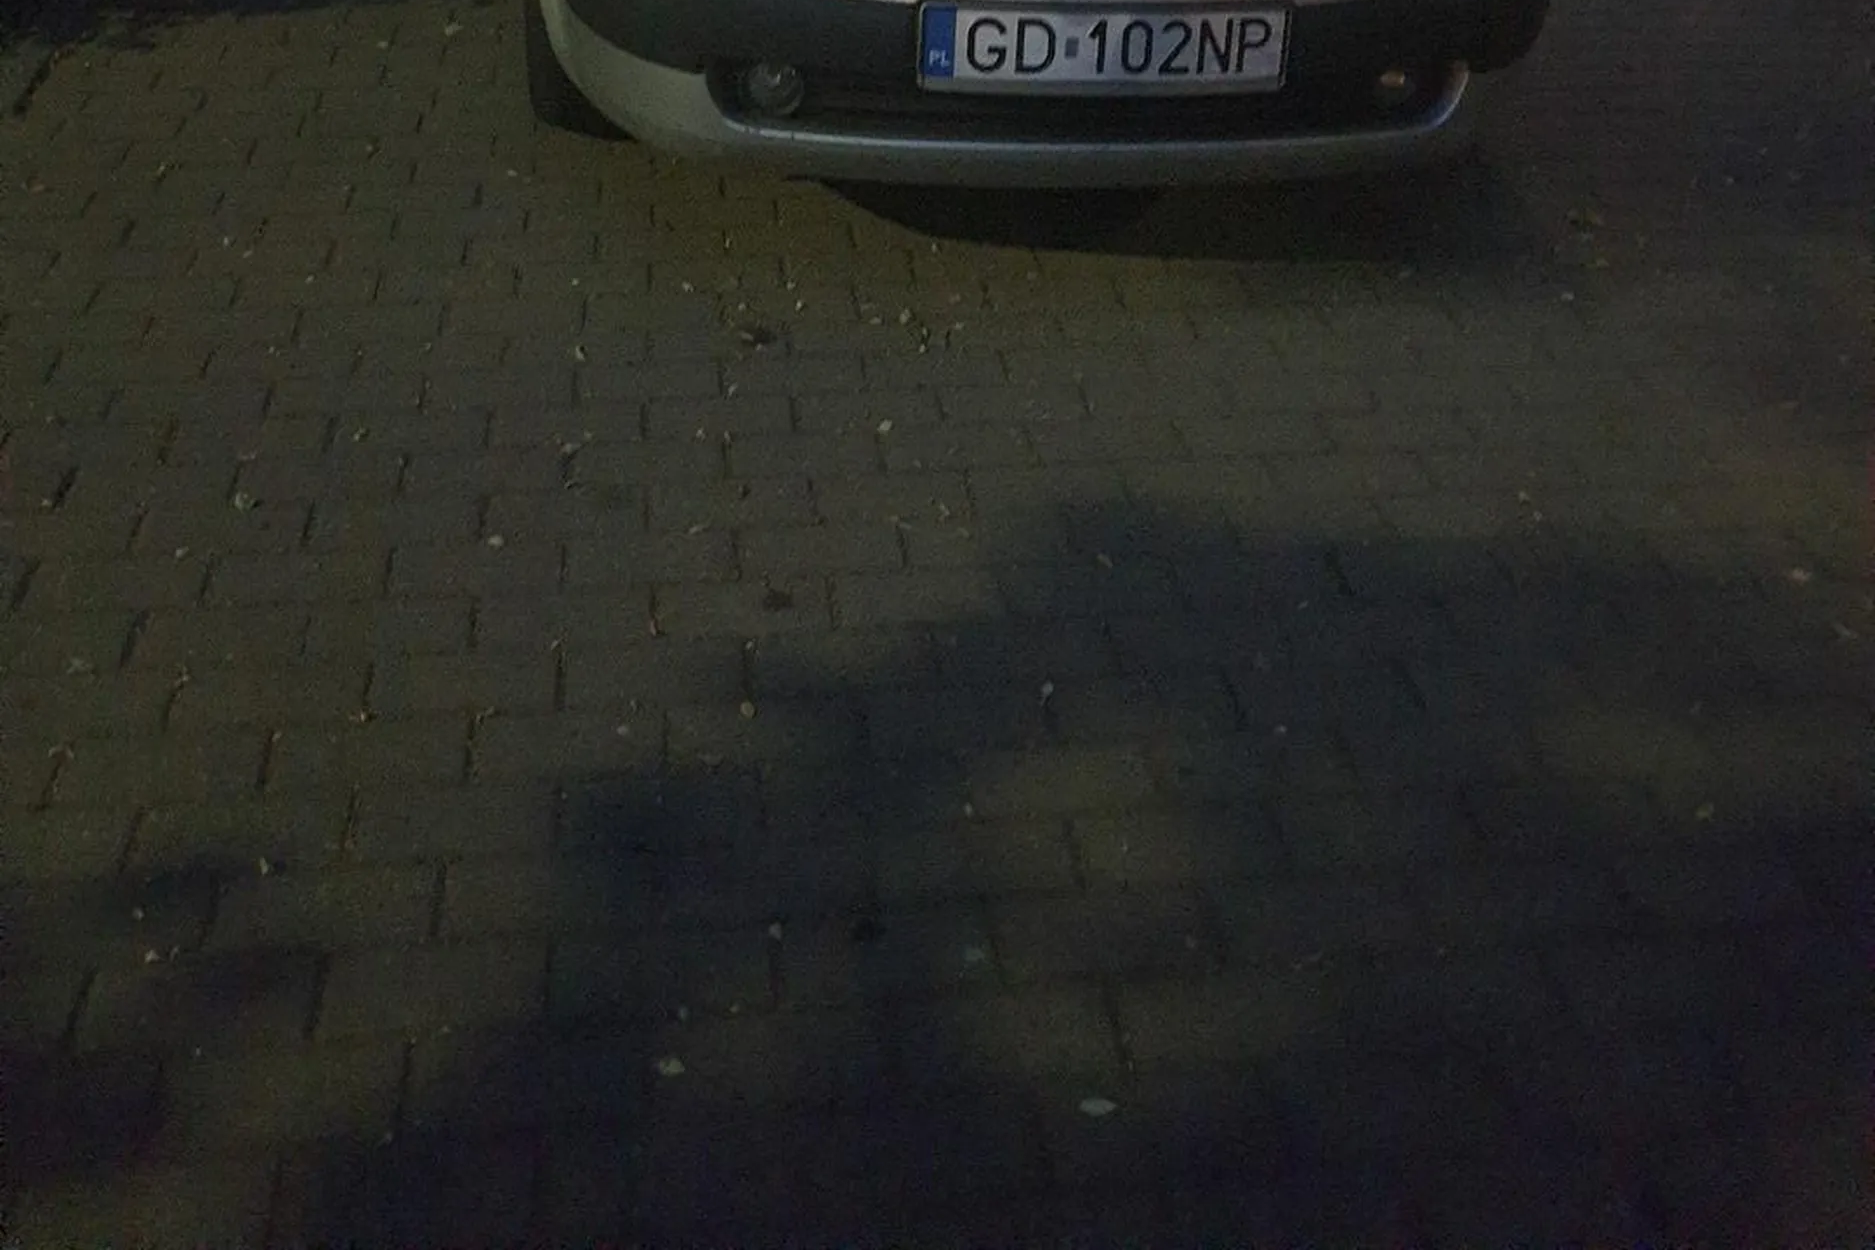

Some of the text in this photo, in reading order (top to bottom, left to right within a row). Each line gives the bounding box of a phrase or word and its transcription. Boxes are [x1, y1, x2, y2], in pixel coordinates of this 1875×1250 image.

[929, 49, 950, 67] PL
[966, 17, 1273, 76] GD 102NP
